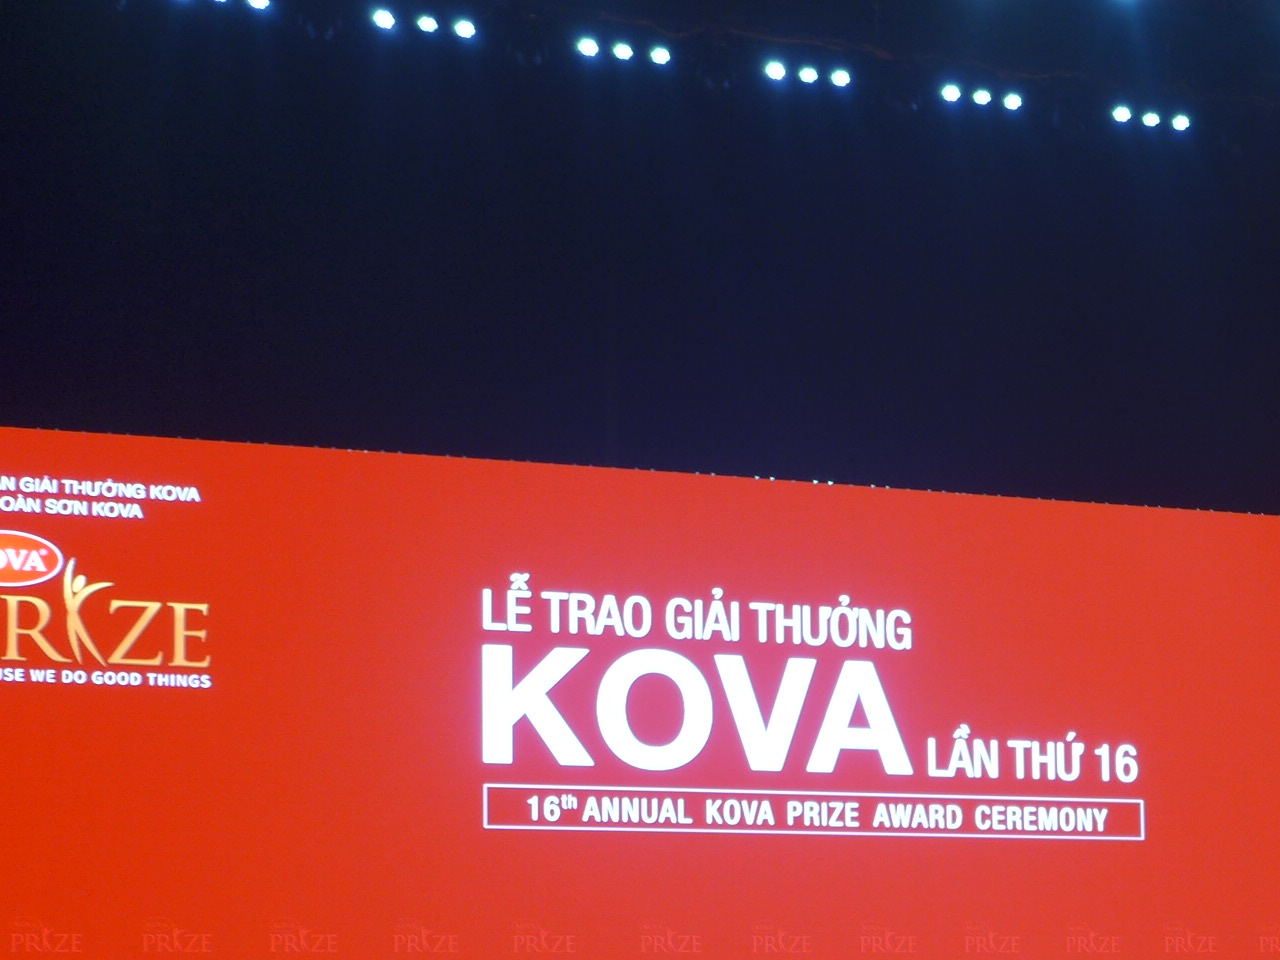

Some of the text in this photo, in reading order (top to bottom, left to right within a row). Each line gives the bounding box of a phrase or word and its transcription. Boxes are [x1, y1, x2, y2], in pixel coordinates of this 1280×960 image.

[0, 474, 201, 502] N GIẢI THƯỞNG KOVA
[44, 498, 89, 516] SƠN
[91, 502, 144, 519] KOVA
[482, 572, 912, 650] LỄ TRAO GIẢI THƯỞNG
[0, 667, 212, 689] SE WE DO GOOD THINGS
[481, 644, 914, 776] KOVA
[927, 723, 1139, 784] LẦN THỨ 16
[527, 794, 1108, 832] 16th ANNUAL KOVA PRIZE AWARD CEREMONY
